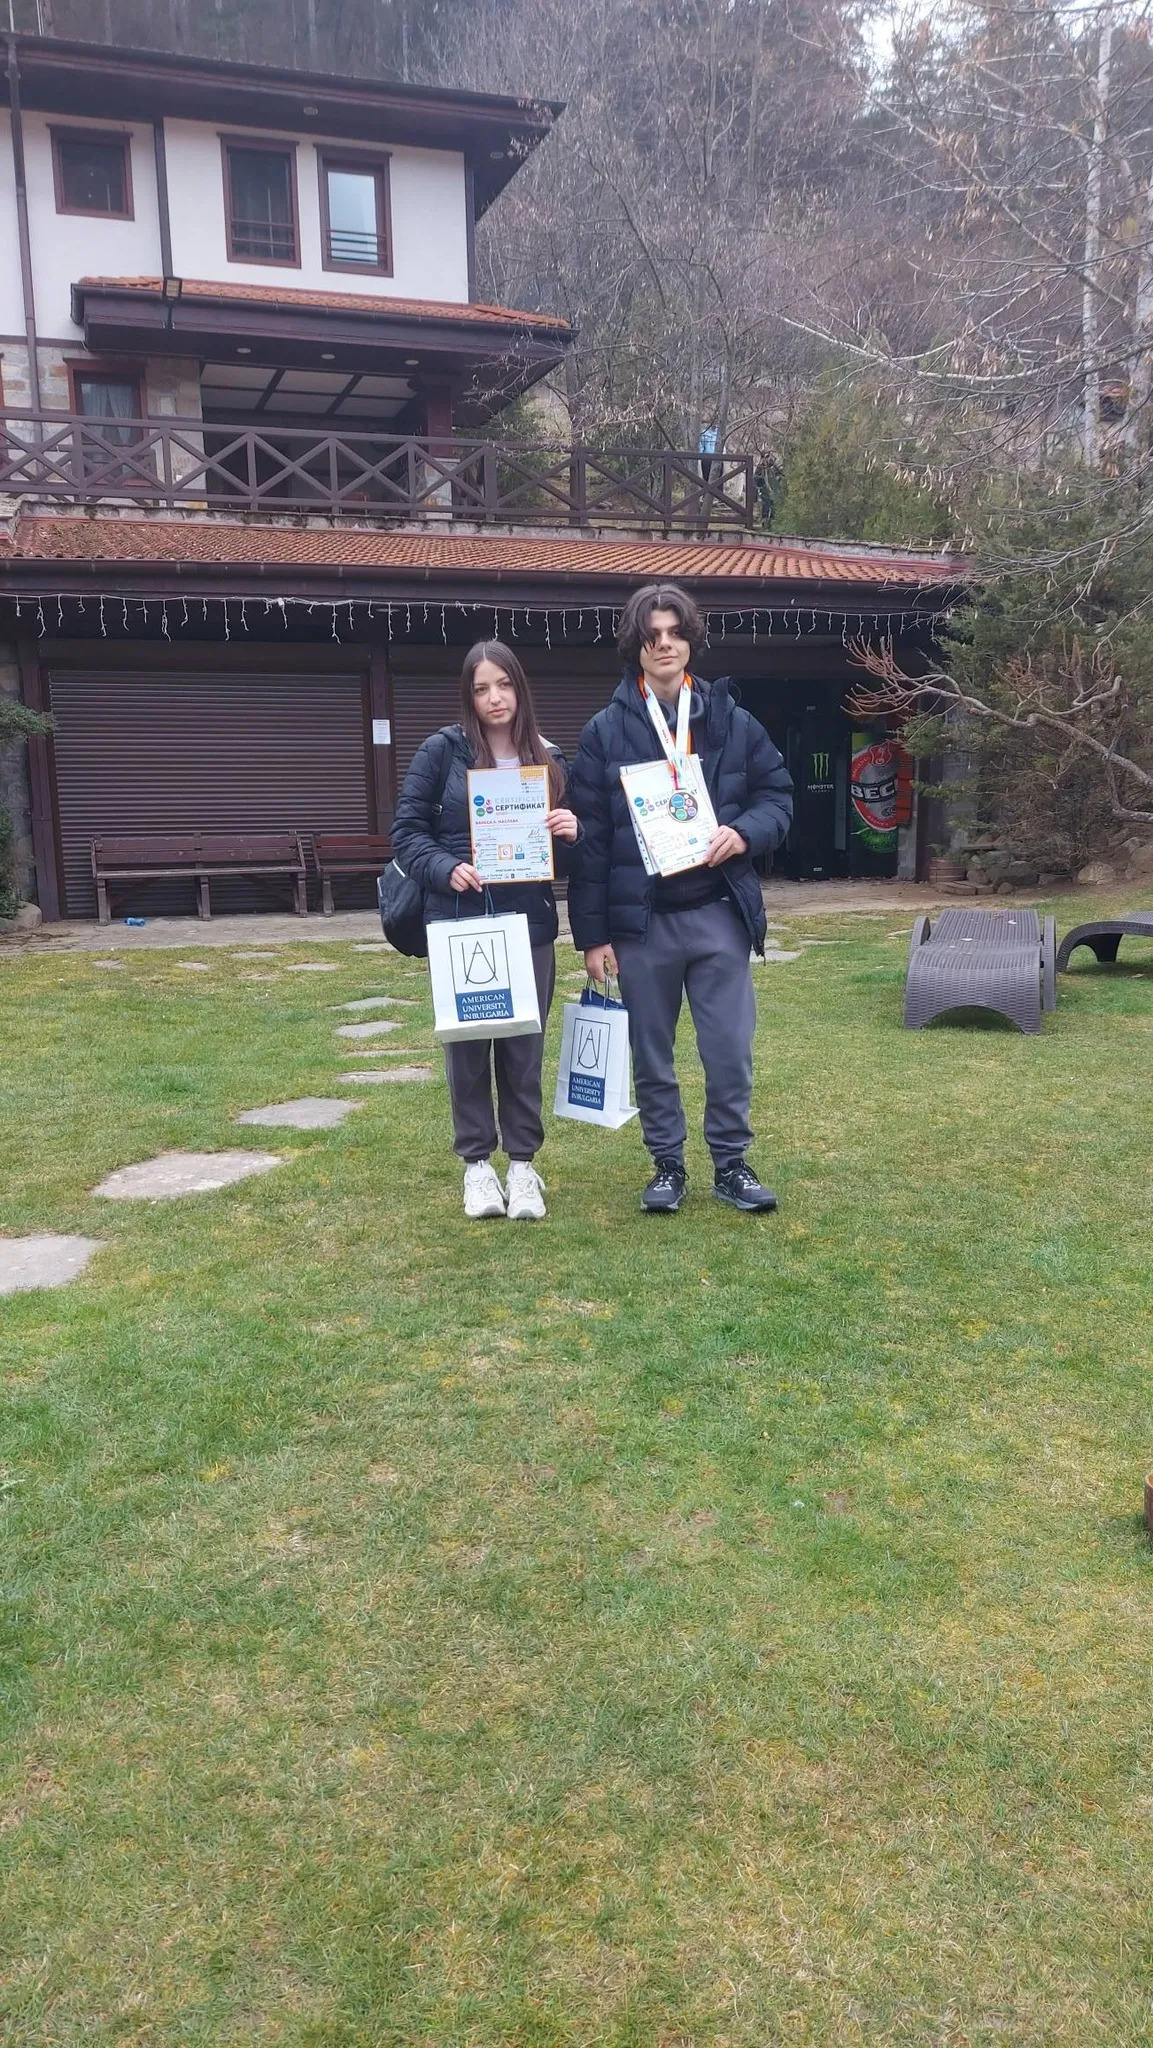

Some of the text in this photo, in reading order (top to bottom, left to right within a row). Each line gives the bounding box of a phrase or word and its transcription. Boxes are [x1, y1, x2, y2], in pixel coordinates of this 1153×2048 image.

[851, 780, 897, 799] BEC
[495, 802, 546, 811] СЕРТИФИКАТ
[461, 993, 505, 1005] AMERICAN
[462, 1001, 508, 1013] UNIVERSITY
[572, 1076, 601, 1089] AMERICAN
[571, 1084, 601, 1097] UNIVERSITY
